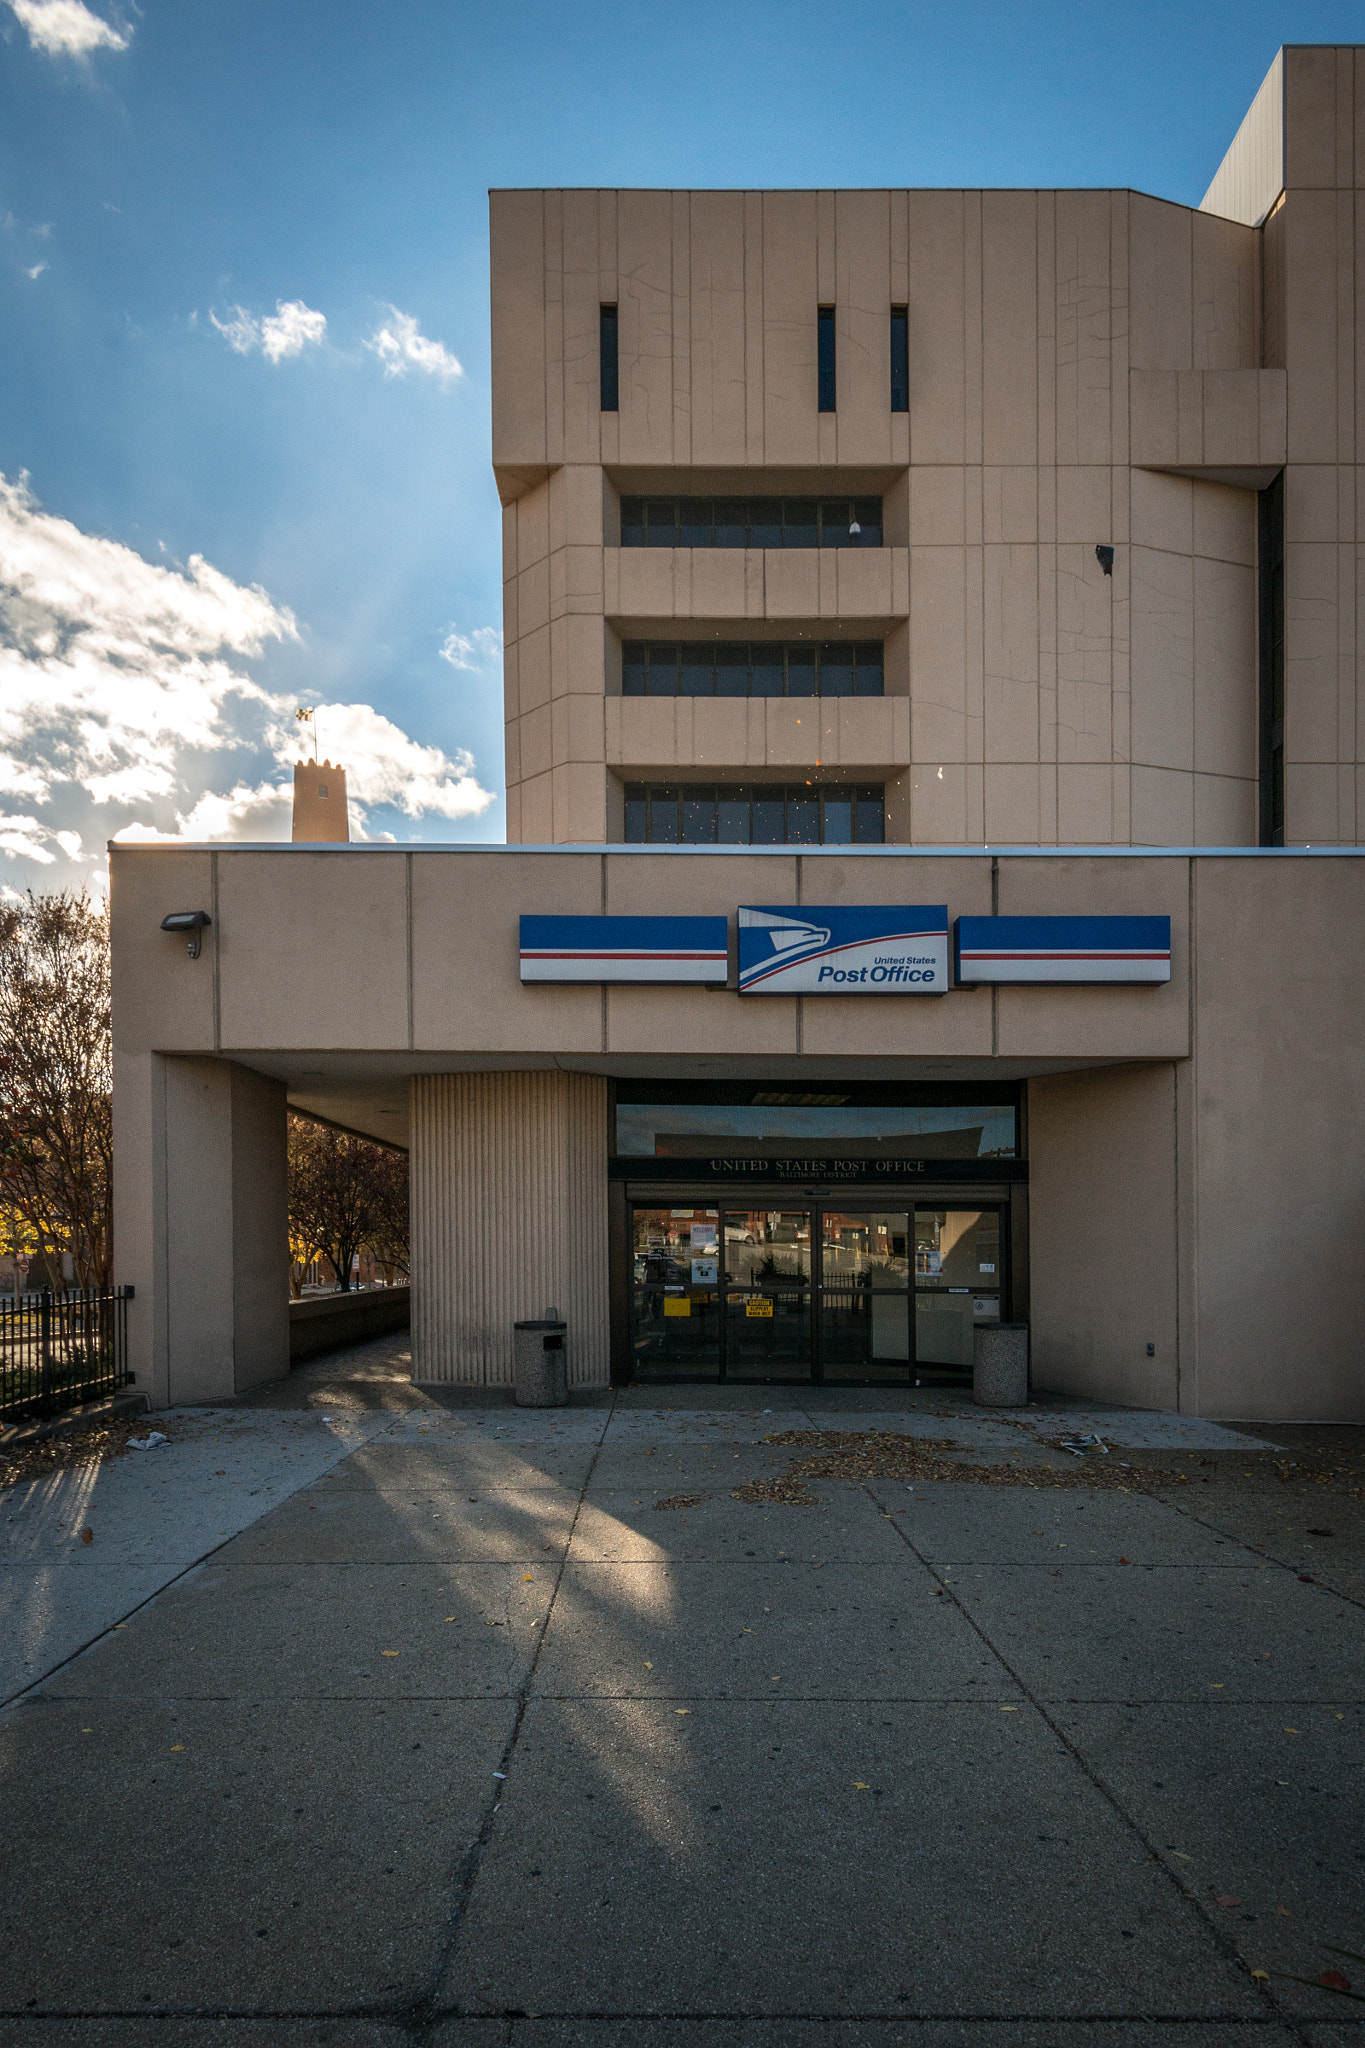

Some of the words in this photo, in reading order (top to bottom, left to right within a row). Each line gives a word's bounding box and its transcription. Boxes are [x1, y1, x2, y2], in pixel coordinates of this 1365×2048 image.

[874, 956, 905, 965] United
[906, 956, 937, 965] States
[817, 966, 869, 983] Post
[869, 965, 935, 983] Office
[710, 1160, 769, 1171] UNITED
[775, 1160, 827, 1171] STATES
[833, 1160, 868, 1171] POST
[875, 1160, 926, 1172] OFFICE
